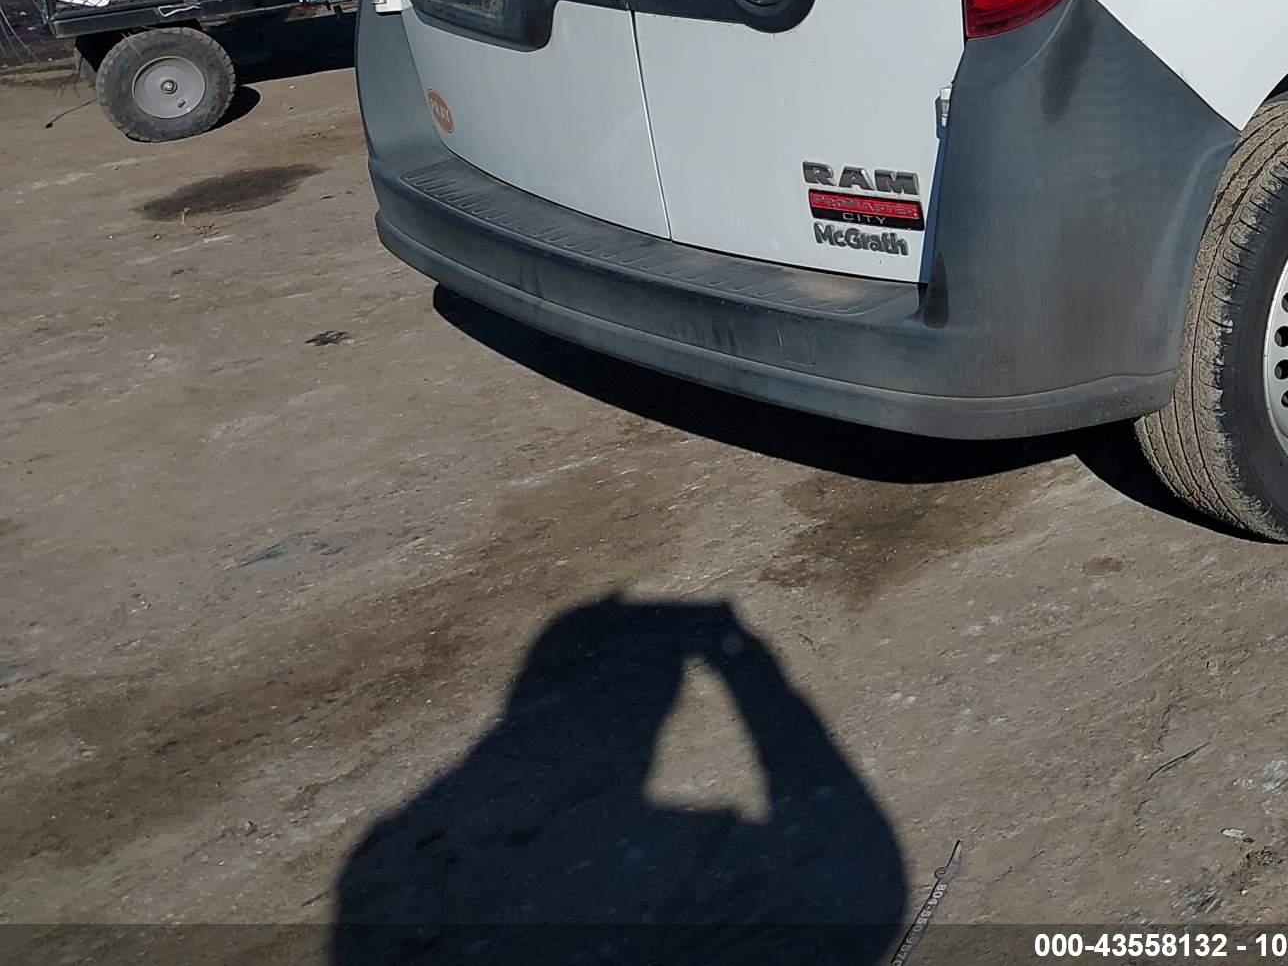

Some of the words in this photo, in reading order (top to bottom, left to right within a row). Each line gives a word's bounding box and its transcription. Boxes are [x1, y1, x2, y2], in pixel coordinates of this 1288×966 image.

[802, 160, 920, 195] RAM
[842, 212, 887, 225] CITY
[813, 221, 910, 256] McGrath
